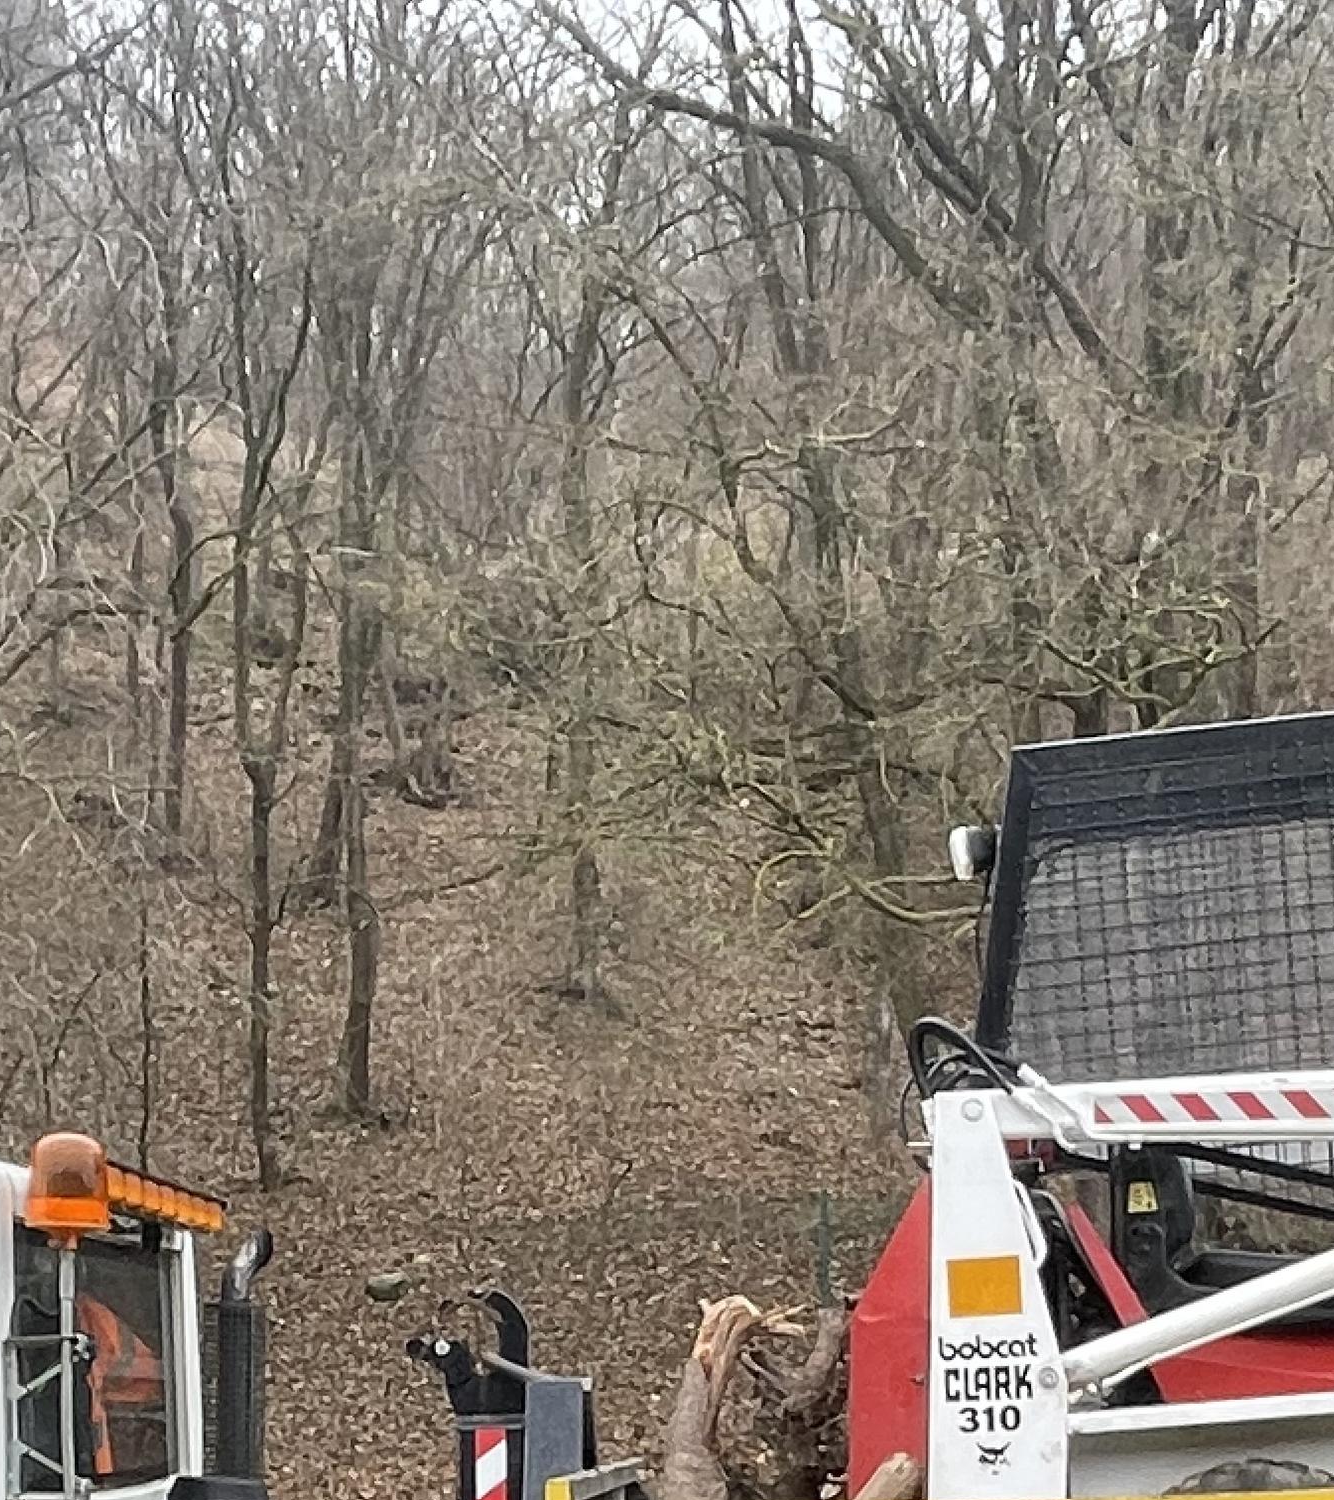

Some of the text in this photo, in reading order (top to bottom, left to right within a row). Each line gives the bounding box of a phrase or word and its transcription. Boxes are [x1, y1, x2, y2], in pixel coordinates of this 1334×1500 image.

[937, 1332, 1038, 1361] bobcat
[944, 1364, 1033, 1402] CLARK
[958, 1405, 1021, 1432] 310
